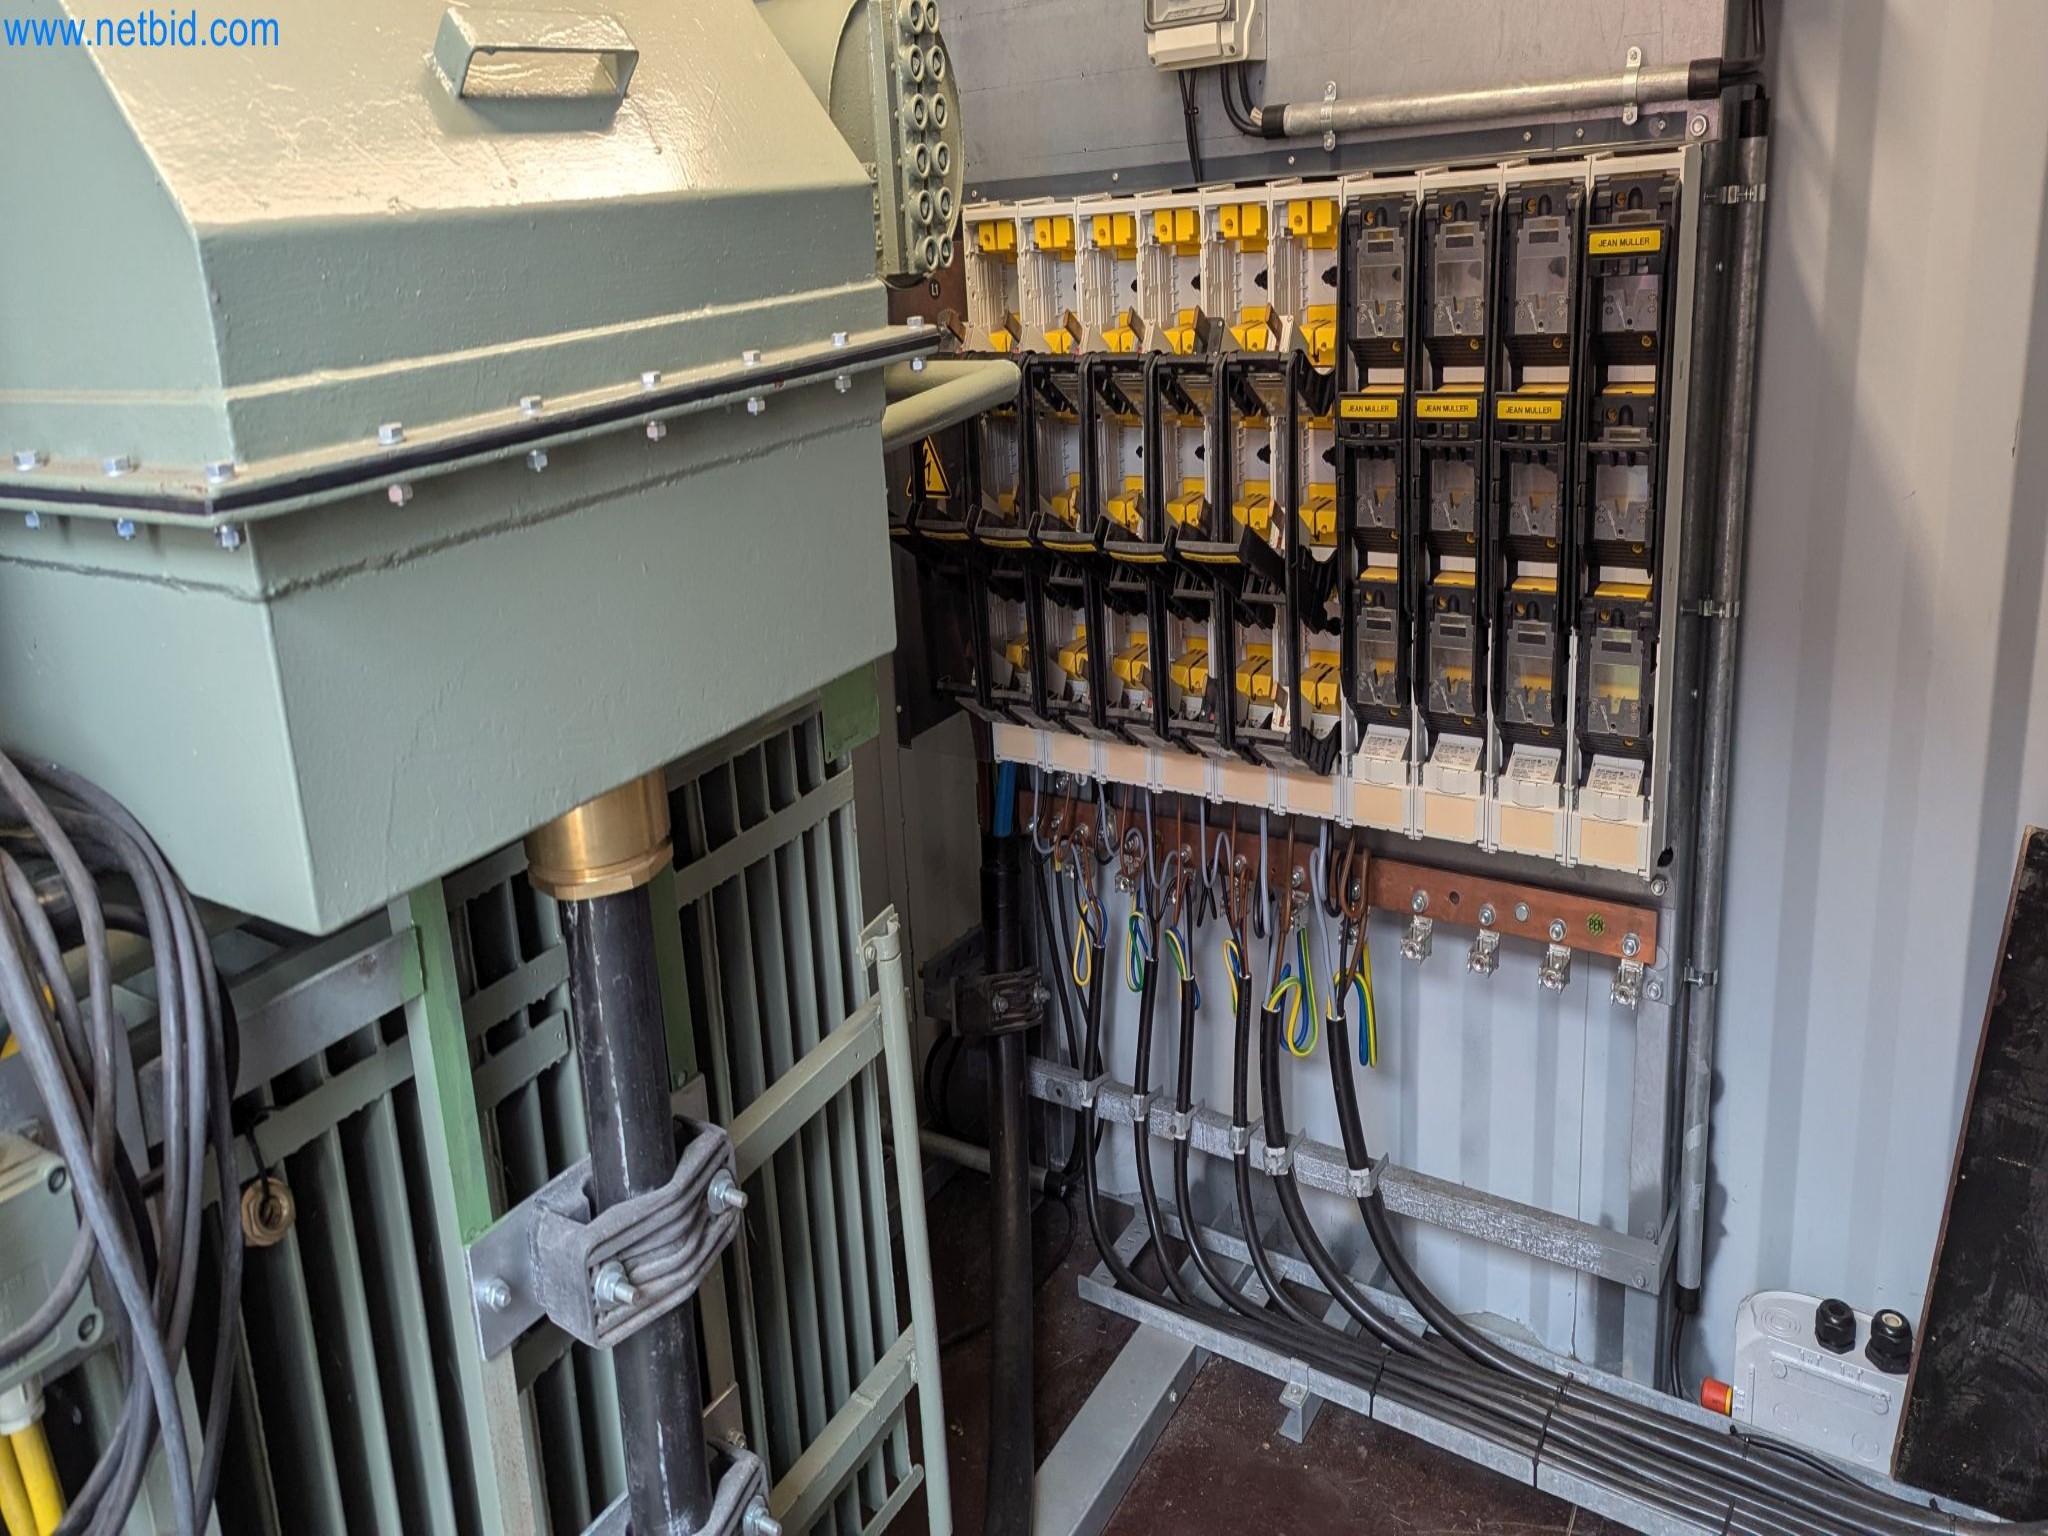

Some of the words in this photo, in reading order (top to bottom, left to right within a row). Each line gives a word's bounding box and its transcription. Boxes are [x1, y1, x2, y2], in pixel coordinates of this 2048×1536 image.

[1598, 239, 1617, 248] JEAN
[931, 283, 939, 296] L1
[1348, 404, 1363, 413] JEAN
[1424, 404, 1441, 412] JEAN
[1505, 406, 1523, 414] JEAN
[1589, 917, 1604, 931] PEN
